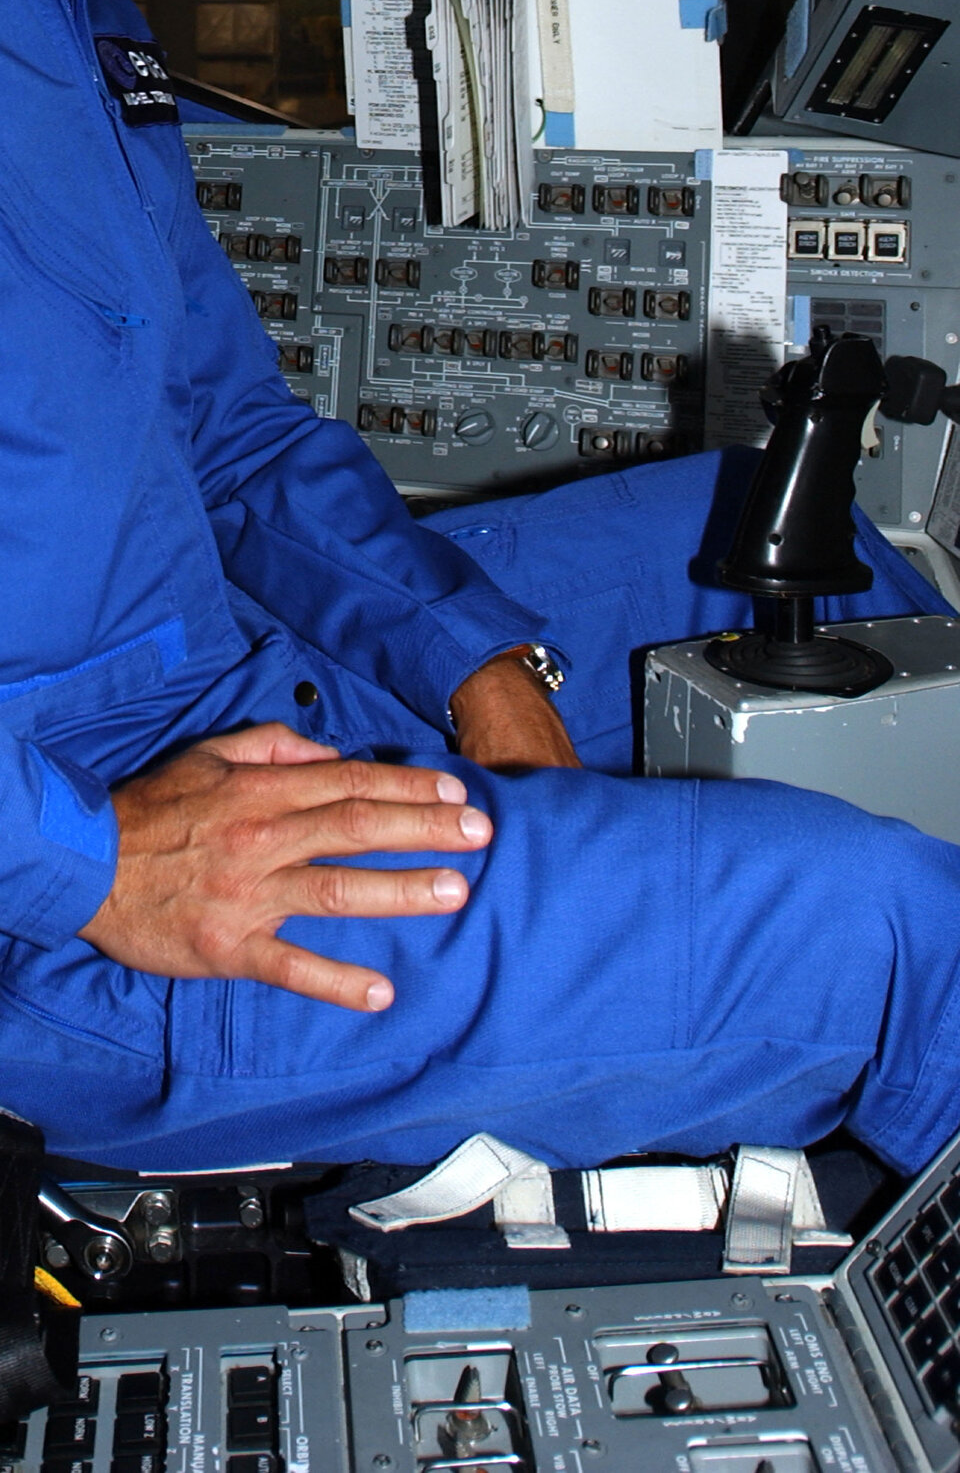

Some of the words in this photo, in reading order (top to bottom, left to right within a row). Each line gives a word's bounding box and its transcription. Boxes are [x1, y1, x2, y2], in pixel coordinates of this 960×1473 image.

[789, 1328, 804, 1346] LEFT
[803, 1334, 824, 1359] OMS
[532, 1352, 545, 1370] LEFT
[784, 1350, 800, 1371] ARM
[813, 1360, 834, 1384] ENG
[281, 1369, 293, 1396] SELECT
[548, 1365, 562, 1391] PROBE
[560, 1367, 575, 1385] AIR
[586, 1365, 600, 1381] OFF
[805, 1368, 824, 1395] RIGHT
[77, 1377, 90, 1401] NORM
[391, 1385, 405, 1416] INHIBIT
[525, 1377, 541, 1408] ENABLE
[178, 1373, 194, 1444] TRANSLATION
[552, 1391, 567, 1418] STOW
[564, 1387, 582, 1416] DATA
[74, 1418, 86, 1442] NORM
[143, 1413, 156, 1431] LOW
[544, 1410, 559, 1437] RIGHT
[675, 1454, 690, 1473] OFF
[821, 1447, 836, 1464] ON
